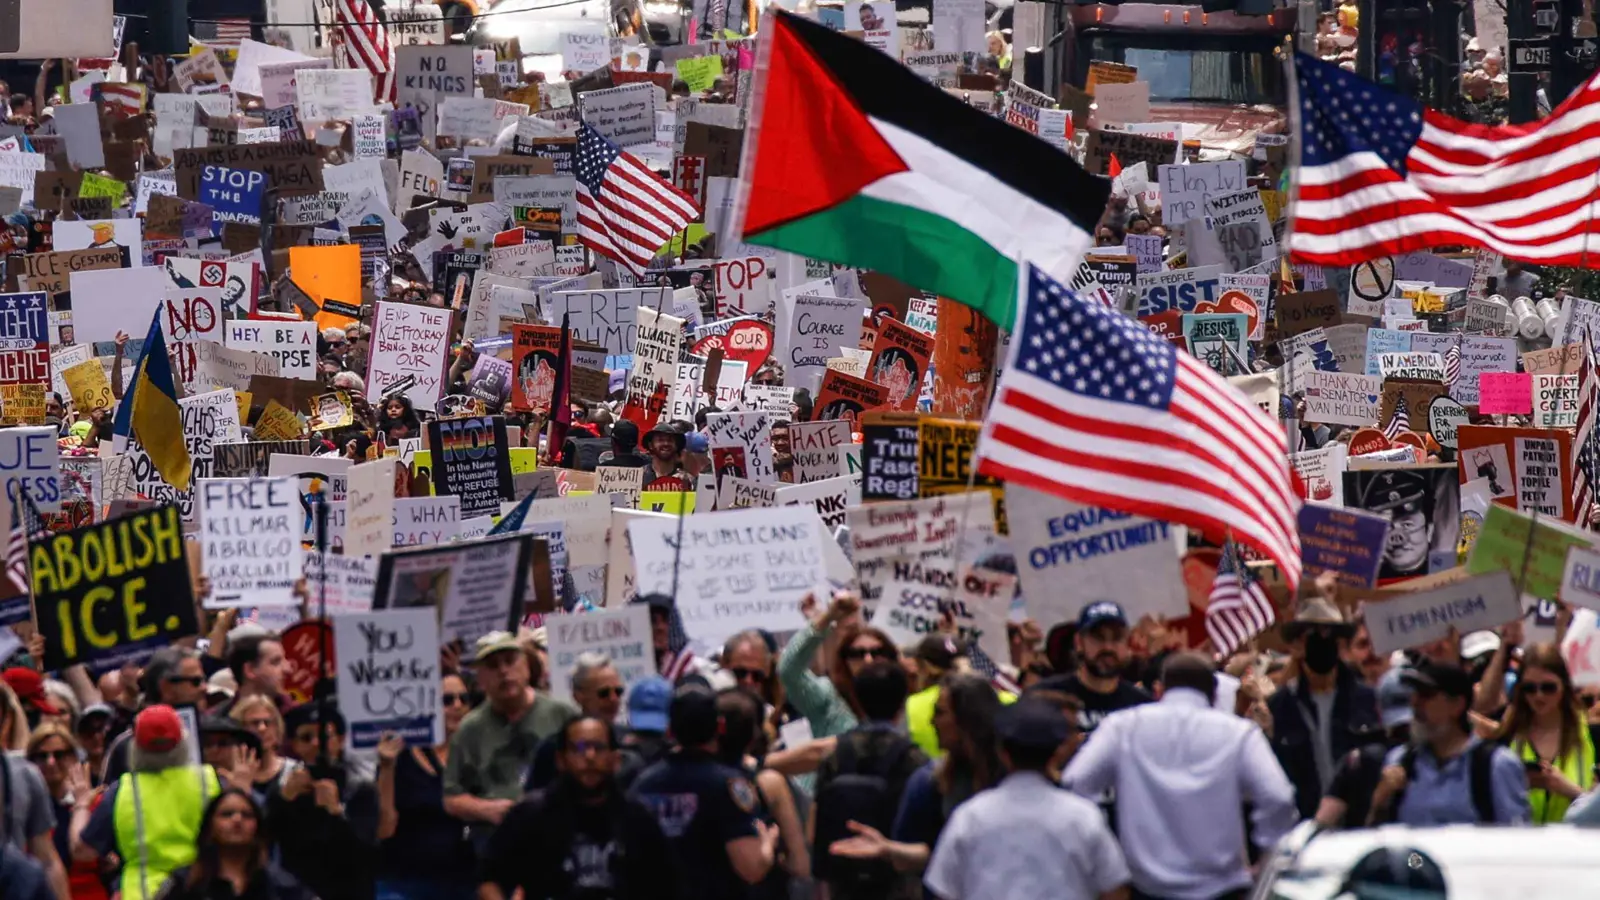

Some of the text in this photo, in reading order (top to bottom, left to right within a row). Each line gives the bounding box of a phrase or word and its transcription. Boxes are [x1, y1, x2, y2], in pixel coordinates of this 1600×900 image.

[393, 23, 437, 34] JUSTICE
[418, 56, 447, 72] NO
[405, 77, 465, 93] KINGS
[209, 131, 238, 145] ICE
[536, 150, 571, 160] Trump
[203, 165, 264, 192] STOP
[209, 189, 241, 203] THE
[1211, 190, 1259, 209] WITHOUT
[1126, 236, 1160, 258] FREE
[27, 253, 119, 279] ICE GESTAPO
[453, 254, 477, 262] DIED
[1103, 262, 1119, 270] The
[715, 257, 765, 293] TOP
[1161, 271, 1195, 284] PEOPLE
[1225, 276, 1239, 285] THE
[1253, 287, 1265, 297] BE
[565, 291, 662, 325] FREE
[909, 300, 927, 313] KEEP
[1303, 302, 1336, 321] Kings
[167, 296, 216, 335] NO
[386, 308, 443, 325] END THE
[797, 312, 845, 337] COURAGE
[1196, 320, 1236, 337] RESIST
[15, 340, 33, 348] YOUR
[275, 329, 294, 343] BE
[301, 331, 311, 344] A
[638, 324, 676, 348] CLIMATE
[734, 332, 763, 346] OUR
[812, 338, 829, 350] IS
[1430, 337, 1449, 349] your
[411, 342, 439, 355] BACK
[396, 353, 431, 368] OUR
[482, 358, 512, 375] FREE
[576, 356, 598, 366] Make
[1383, 355, 1394, 368] IN
[1470, 353, 1489, 365] your
[1307, 372, 1375, 391] THANK YOU
[1321, 389, 1367, 404] SENATOR
[1308, 401, 1330, 415] VAN
[709, 415, 733, 436] HOW
[739, 415, 767, 446] YOUR
[1435, 418, 1451, 428] FOR
[440, 416, 497, 463] NO!
[726, 425, 741, 440] IS
[792, 425, 842, 451] HATE
[874, 440, 918, 455] Tru
[1351, 436, 1384, 456] HANDS
[1300, 452, 1320, 462] history
[447, 460, 496, 473] In the Name
[1547, 466, 1558, 477] TO
[447, 469, 498, 482] of Humanity
[617, 470, 640, 485] Will
[448, 478, 499, 493] We REFUSE
[867, 475, 919, 499] Regi
[203, 481, 289, 510] FREE
[463, 490, 491, 503] Accept
[474, 495, 508, 509] America
[411, 504, 459, 524] WHAT
[207, 515, 290, 534] KILMAR
[852, 529, 918, 550] Government
[1029, 519, 1170, 569] OPPORTUNITY
[32, 506, 181, 596] ABOLISH
[208, 539, 292, 560] ABREGO
[894, 560, 1001, 597] HANDS OFF
[898, 587, 974, 619] SOCIAL
[56, 576, 180, 660] ICE.
[1387, 595, 1487, 636] FEMINISM
[356, 620, 415, 654] You
